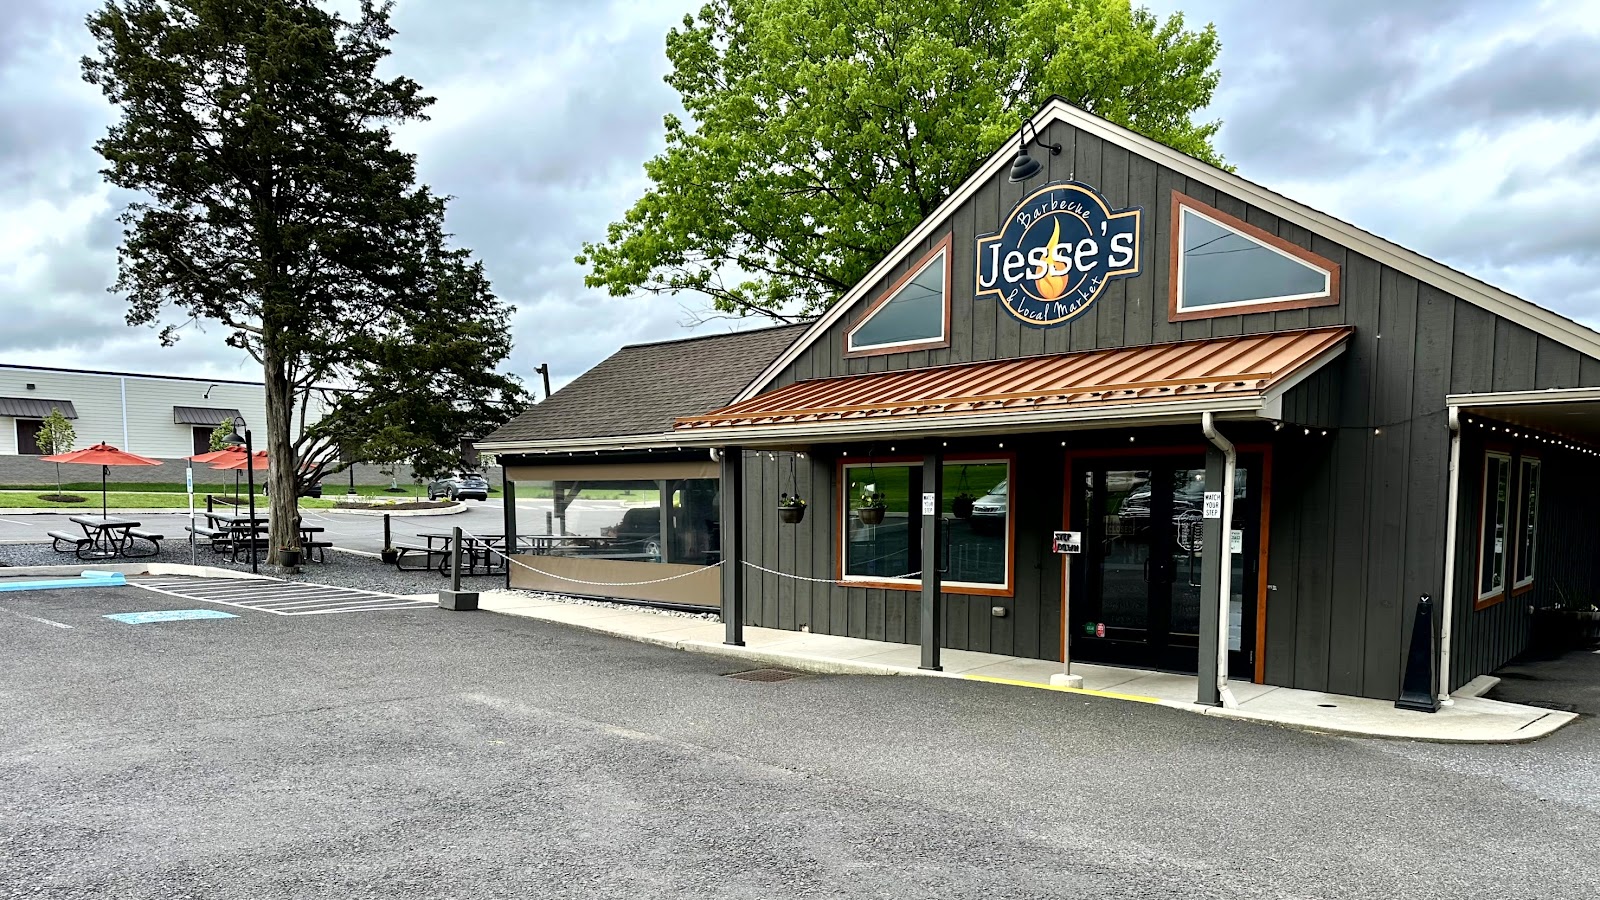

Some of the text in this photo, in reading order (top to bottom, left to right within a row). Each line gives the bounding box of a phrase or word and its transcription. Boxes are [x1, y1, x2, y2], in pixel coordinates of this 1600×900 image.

[1017, 193, 1091, 228] Barbecue
[979, 221, 1134, 287] Jesse's
[1017, 297, 1049, 321] Local
[1053, 276, 1102, 318] Market
[1055, 533, 1072, 542] STEP
[1057, 543, 1080, 552] DOWN
